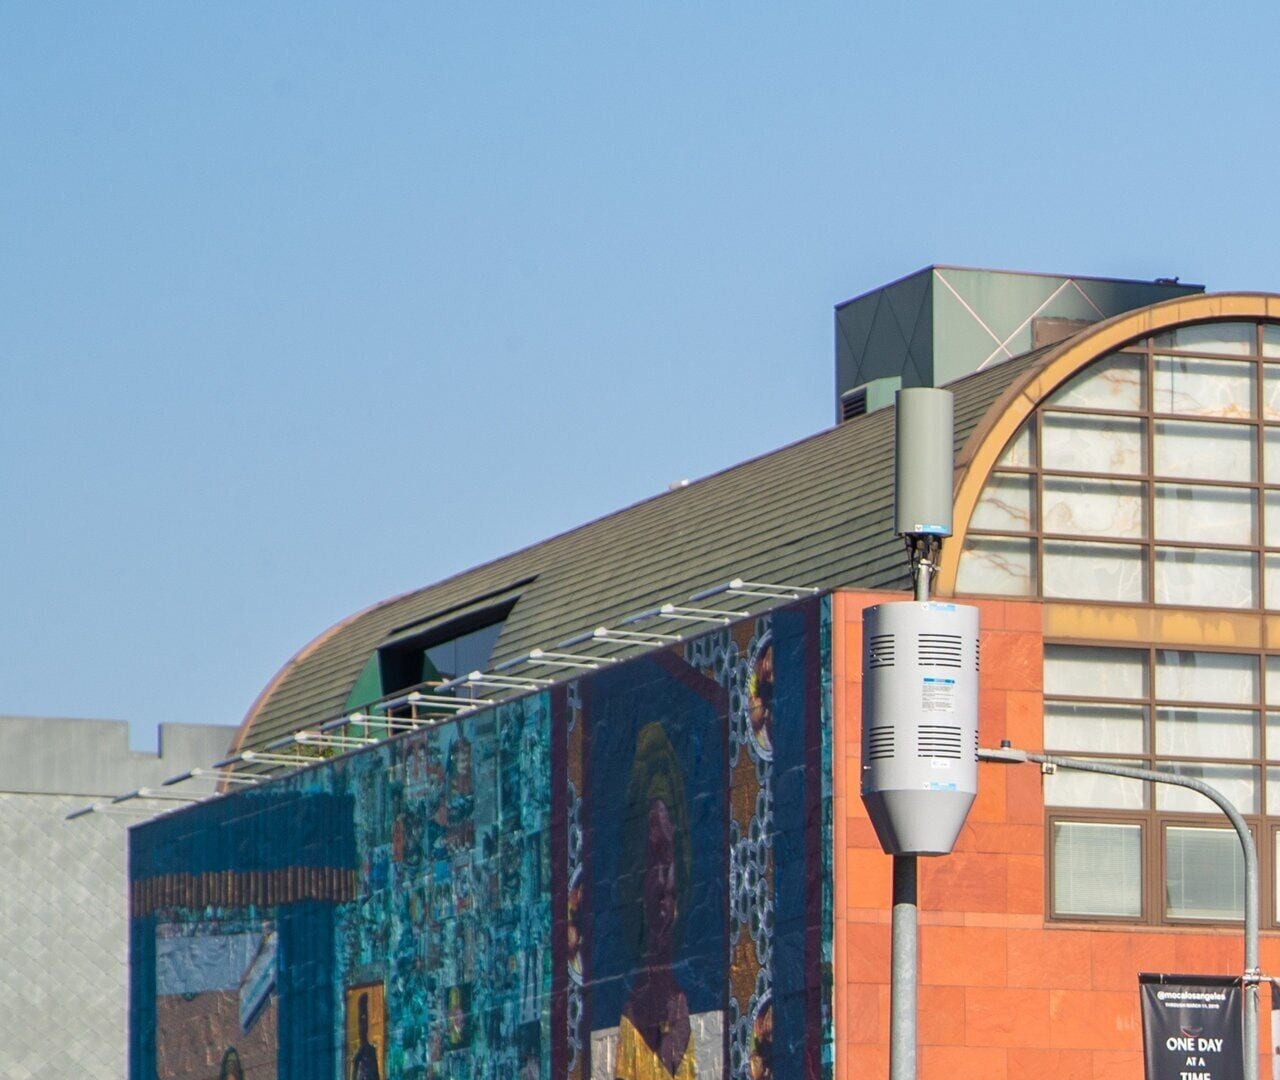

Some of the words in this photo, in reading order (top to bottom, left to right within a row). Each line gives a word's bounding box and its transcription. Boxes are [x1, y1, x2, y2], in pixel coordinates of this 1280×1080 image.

[1157, 991, 1226, 1001] @mocalosangeles
[1166, 1038, 1195, 1051] ONE
[1198, 1038, 1223, 1052] DAY
[1186, 1057, 1196, 1067] AT
[1196, 1058, 1205, 1067] A
